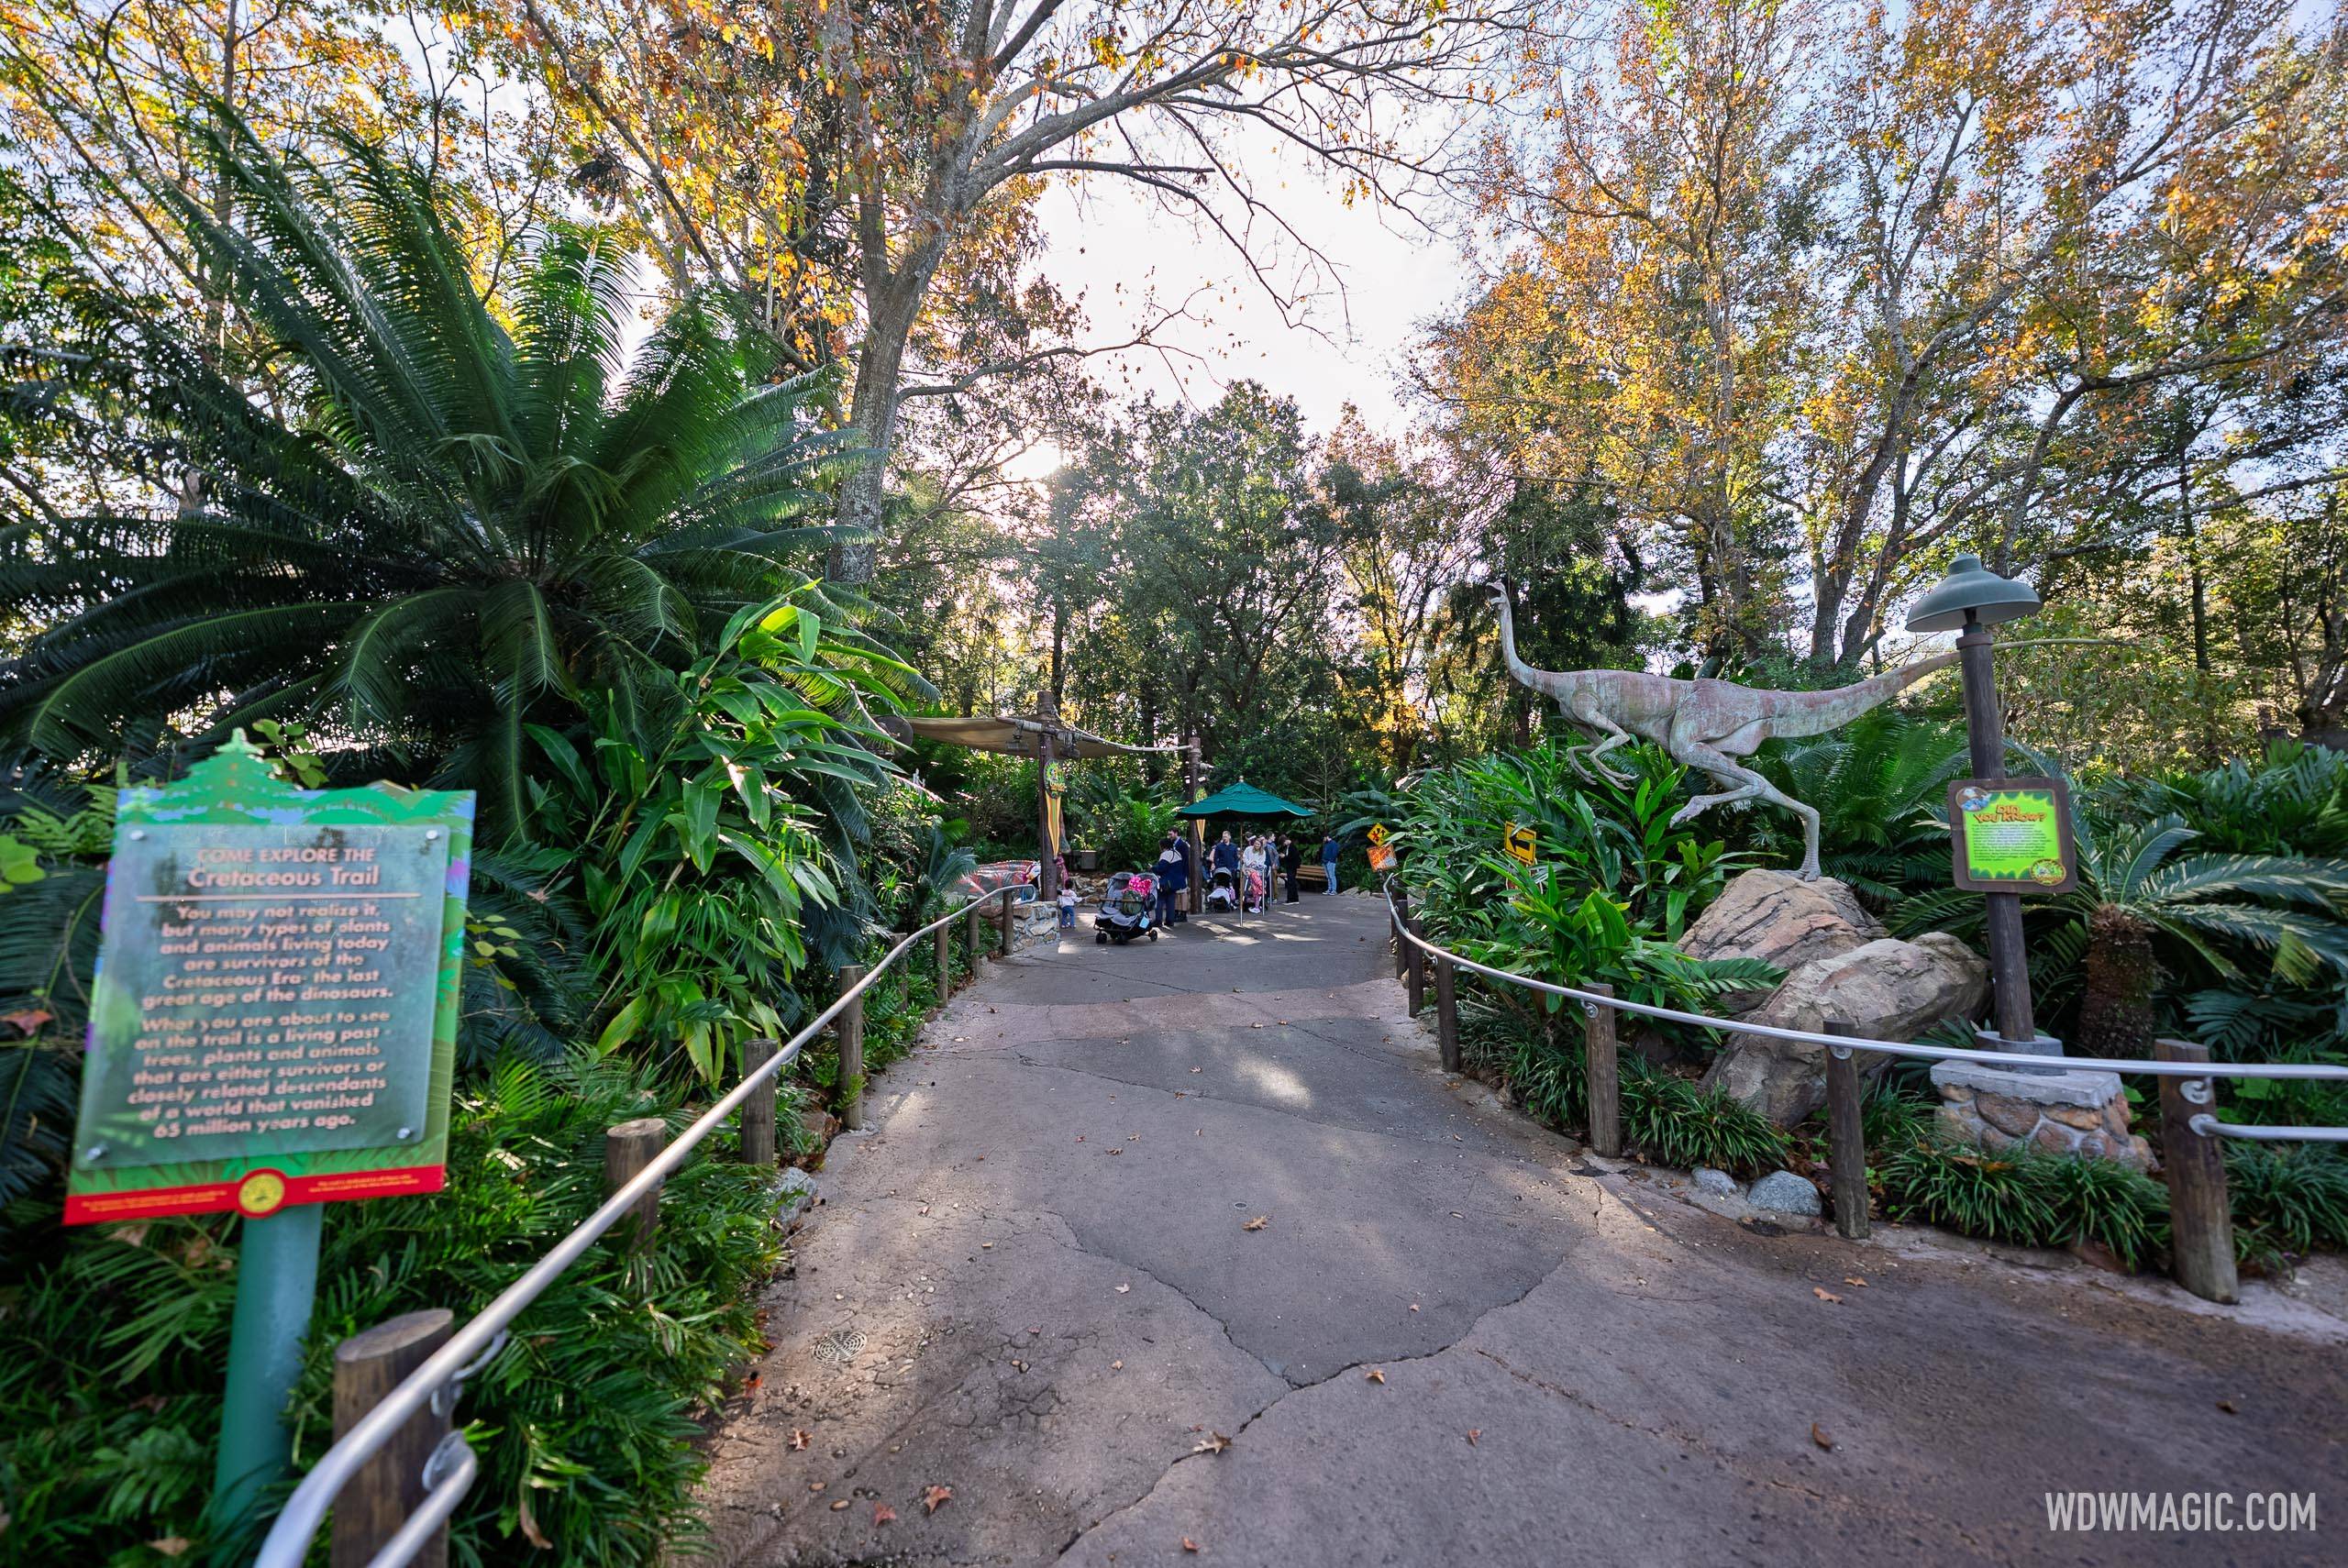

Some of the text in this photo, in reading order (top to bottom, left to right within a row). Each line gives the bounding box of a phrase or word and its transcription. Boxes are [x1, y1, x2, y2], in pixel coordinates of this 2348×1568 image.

[1974, 813, 2046, 823] YOU KNOW?
[1996, 805, 2020, 813] DID
[197, 847, 374, 863] COME EXPLORE THE
[188, 866, 379, 887] Cretaceous Trail
[177, 907, 212, 920] You
[217, 909, 258, 922] may
[264, 905, 294, 917] not
[300, 903, 359, 916] realize
[161, 923, 194, 936] but
[199, 924, 252, 937] many
[259, 922, 307, 936] types
[313, 920, 332, 933] of
[161, 936, 389, 954] and animals living today
[184, 953, 364, 970] are survivors of the
[163, 974, 266, 988] Cretaceous
[314, 970, 341, 983] the
[347, 968, 380, 981] last
[142, 984, 393, 1010] great age of the dinosaurs.
[142, 1017, 194, 1032] What
[241, 1016, 273, 1028] are
[278, 1012, 333, 1026] about
[337, 1010, 355, 1022] to
[360, 1011, 390, 1021] see
[134, 1038, 161, 1050] on
[166, 1034, 196, 1048] the
[203, 1032, 242, 1046] trail
[247, 1032, 261, 1044] is
[267, 1032, 279, 1043] a
[285, 1028, 335, 1043] living
[340, 1026, 380, 1041] past
[203, 1049, 261, 1067] plants
[267, 1046, 305, 1060] and
[308, 1043, 380, 1058] animals
[133, 1061, 386, 1085] that are either survivors or
[127, 1077, 387, 1104] closely related descendants
[139, 1093, 374, 1121] of a world that vanished
[154, 1114, 356, 1138] 65 million years ago.
